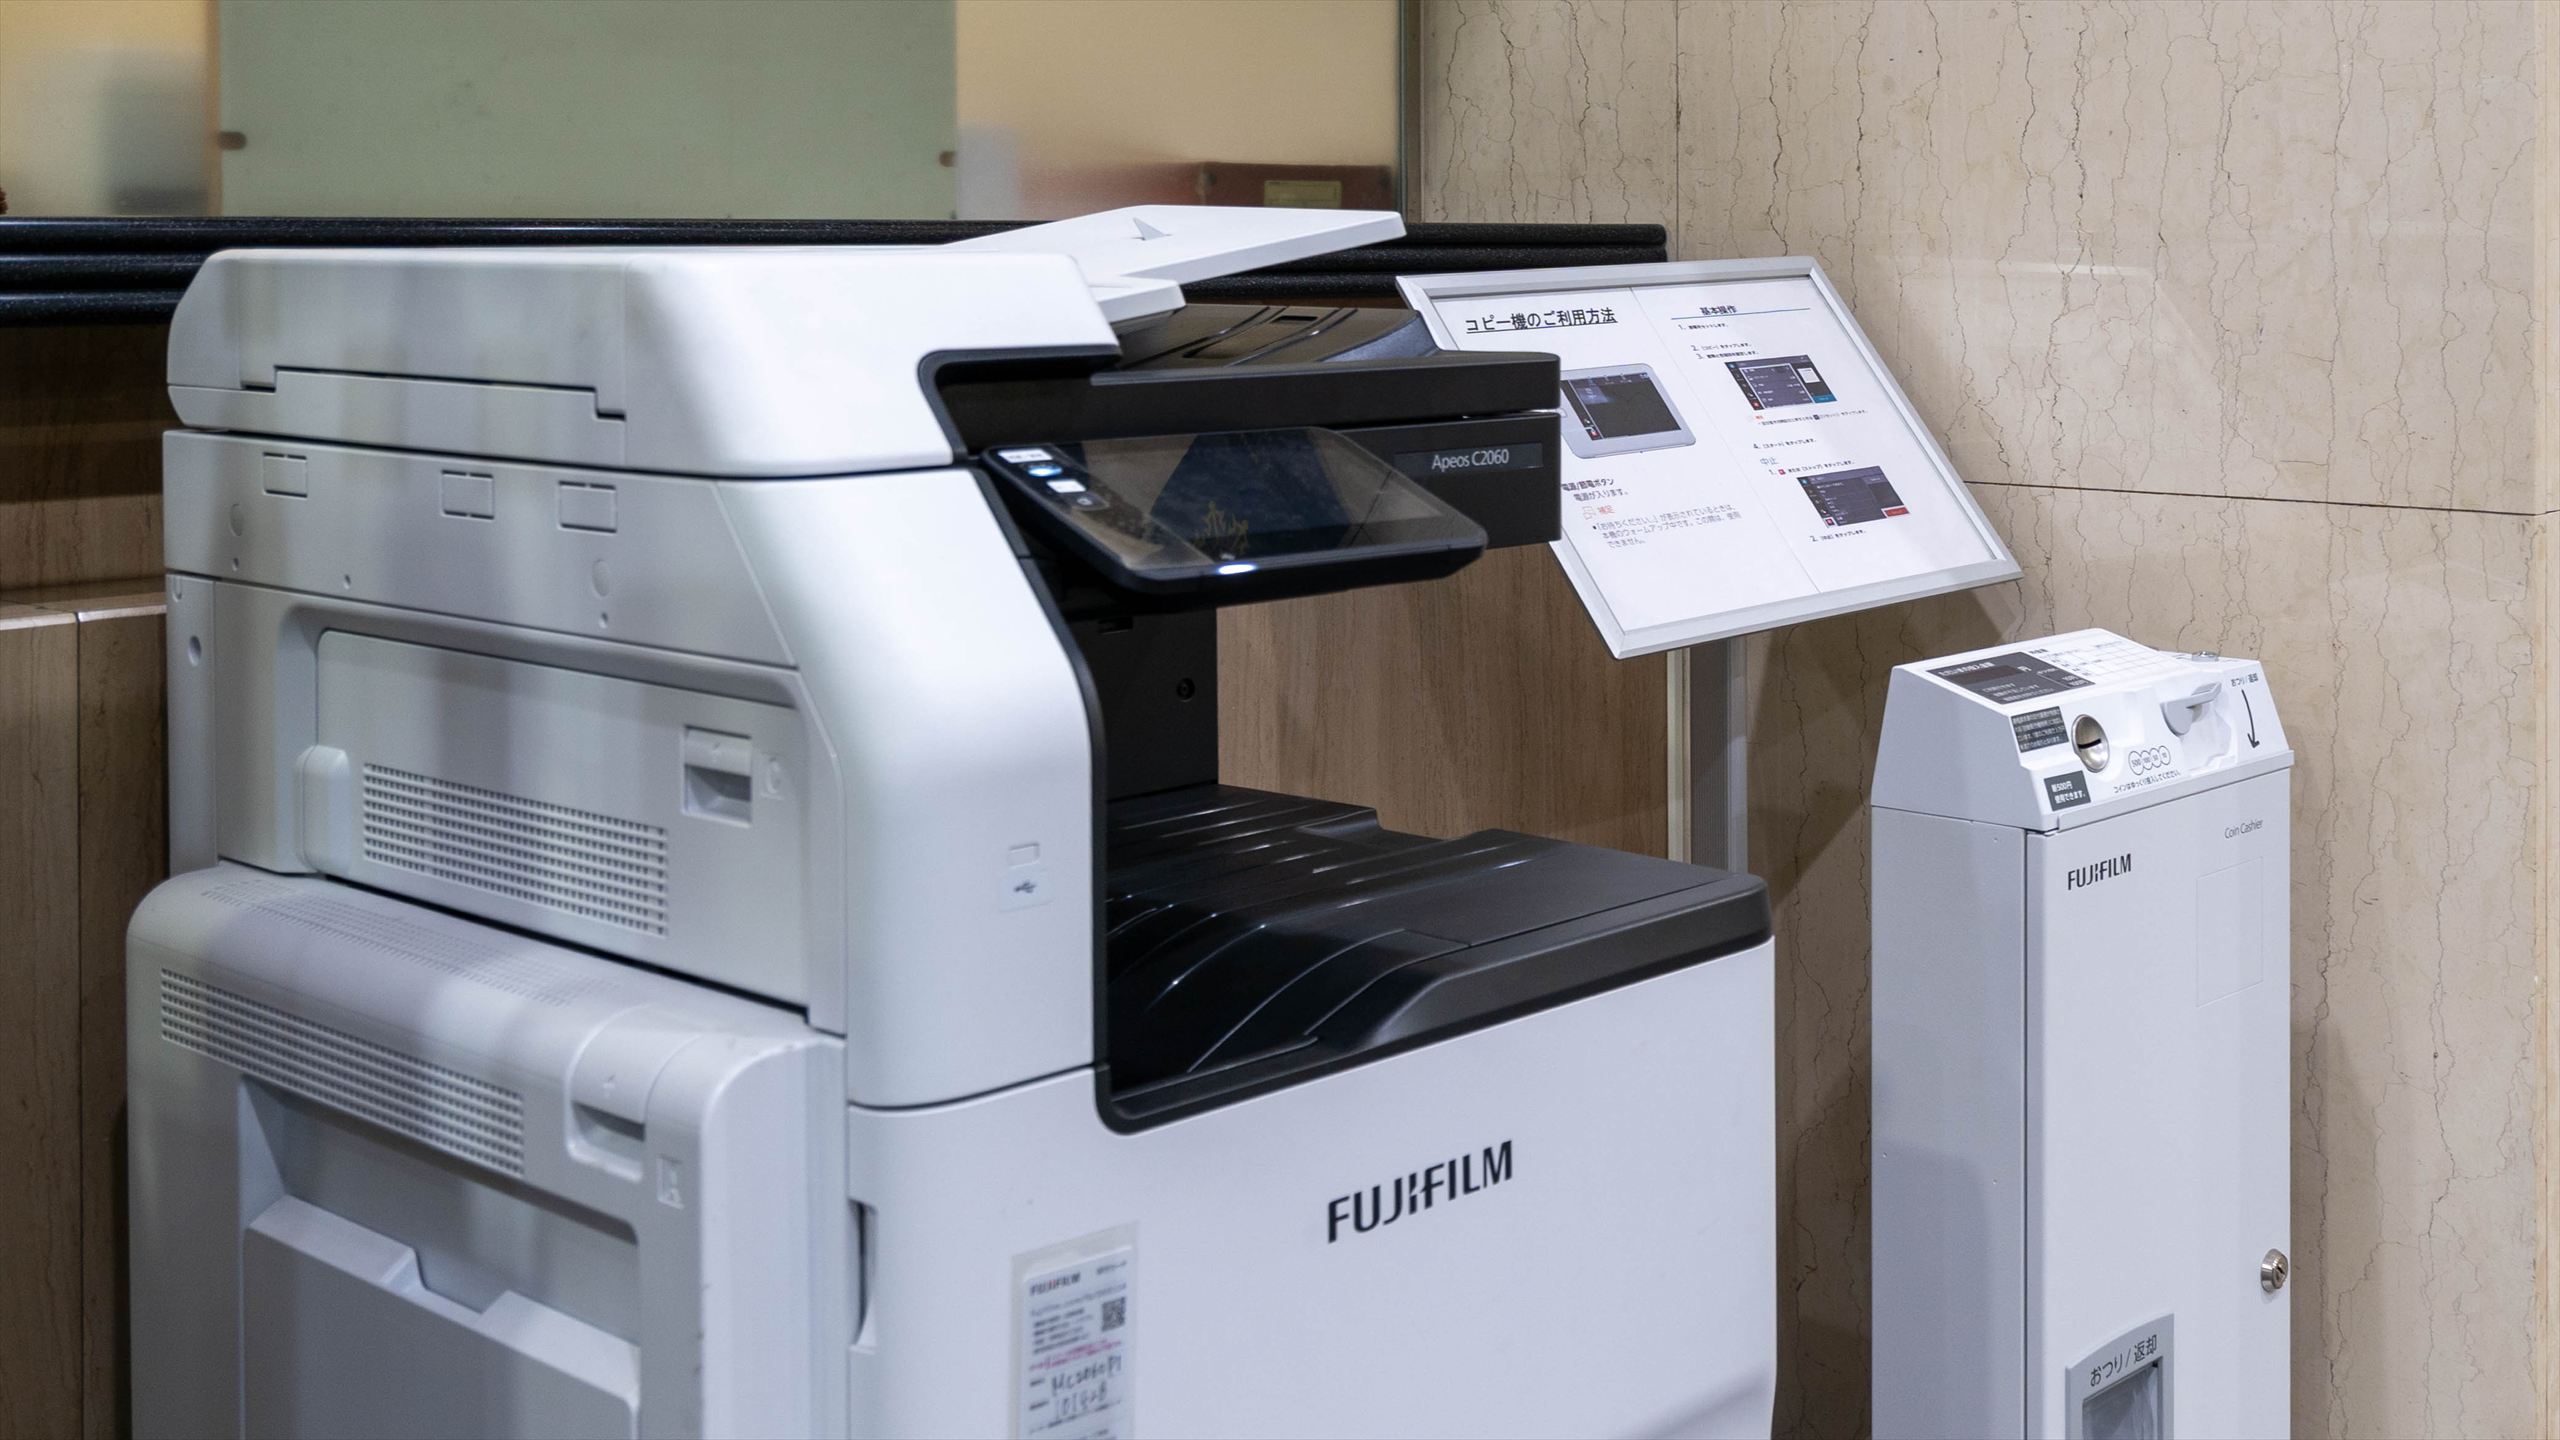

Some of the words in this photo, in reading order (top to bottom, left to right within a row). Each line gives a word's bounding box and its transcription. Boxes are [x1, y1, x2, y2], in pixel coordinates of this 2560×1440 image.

[1465, 307, 1617, 332] コピー機のご利用方法
[1700, 305, 1738, 316] 基本操作
[1432, 454, 1470, 473] Apeos
[1471, 448, 1510, 466] C2060
[2068, 853, 2131, 891] FUJIFILM
[1328, 1140, 1512, 1244] FUJIFILM
[1030, 1271, 1081, 1296] FUJIFILM
